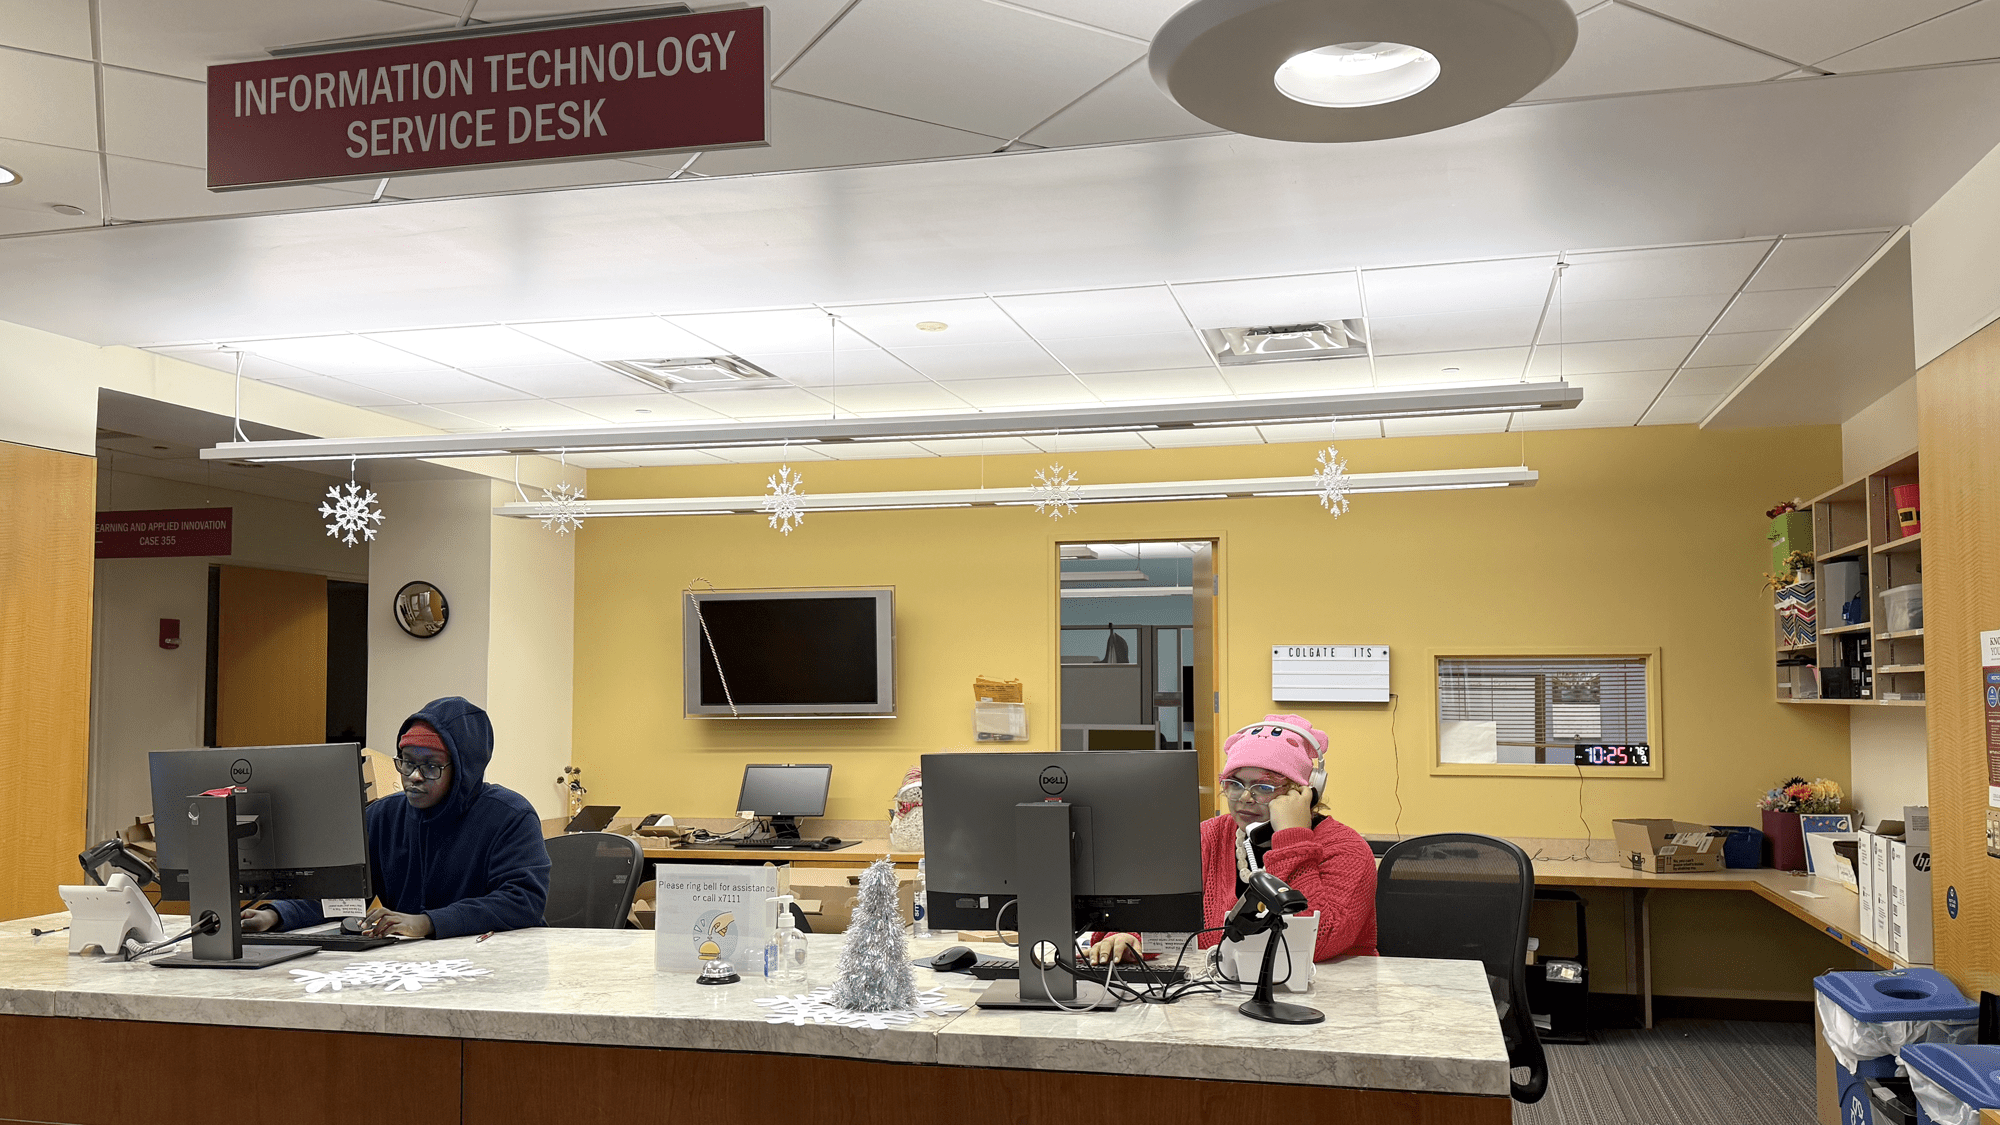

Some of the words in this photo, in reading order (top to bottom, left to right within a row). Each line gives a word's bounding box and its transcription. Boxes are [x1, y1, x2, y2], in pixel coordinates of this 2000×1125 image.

[235, 57, 473, 117] INFORMATION
[484, 31, 736, 93] TECHNOLOGY
[346, 108, 496, 158] SERVICE
[508, 98, 608, 145] DESK
[130, 522, 147, 532] AND
[148, 521, 180, 531] APPLIED
[181, 520, 227, 530] INNOVATION
[139, 536, 160, 546] CASE
[160, 535, 176, 545] 355
[1288, 647, 1335, 658] COLGATE
[1354, 648, 1372, 658] ITS
[1584, 746, 1628, 764] 10:25
[1042, 776, 1065, 785] DELL
[658, 880, 684, 890] Please
[686, 881, 702, 892] ring
[703, 882, 717, 891] bell
[719, 882, 731, 891] for
[732, 883, 776, 893] assistance
[702, 894, 716, 902] call
[717, 894, 741, 903] x7111
